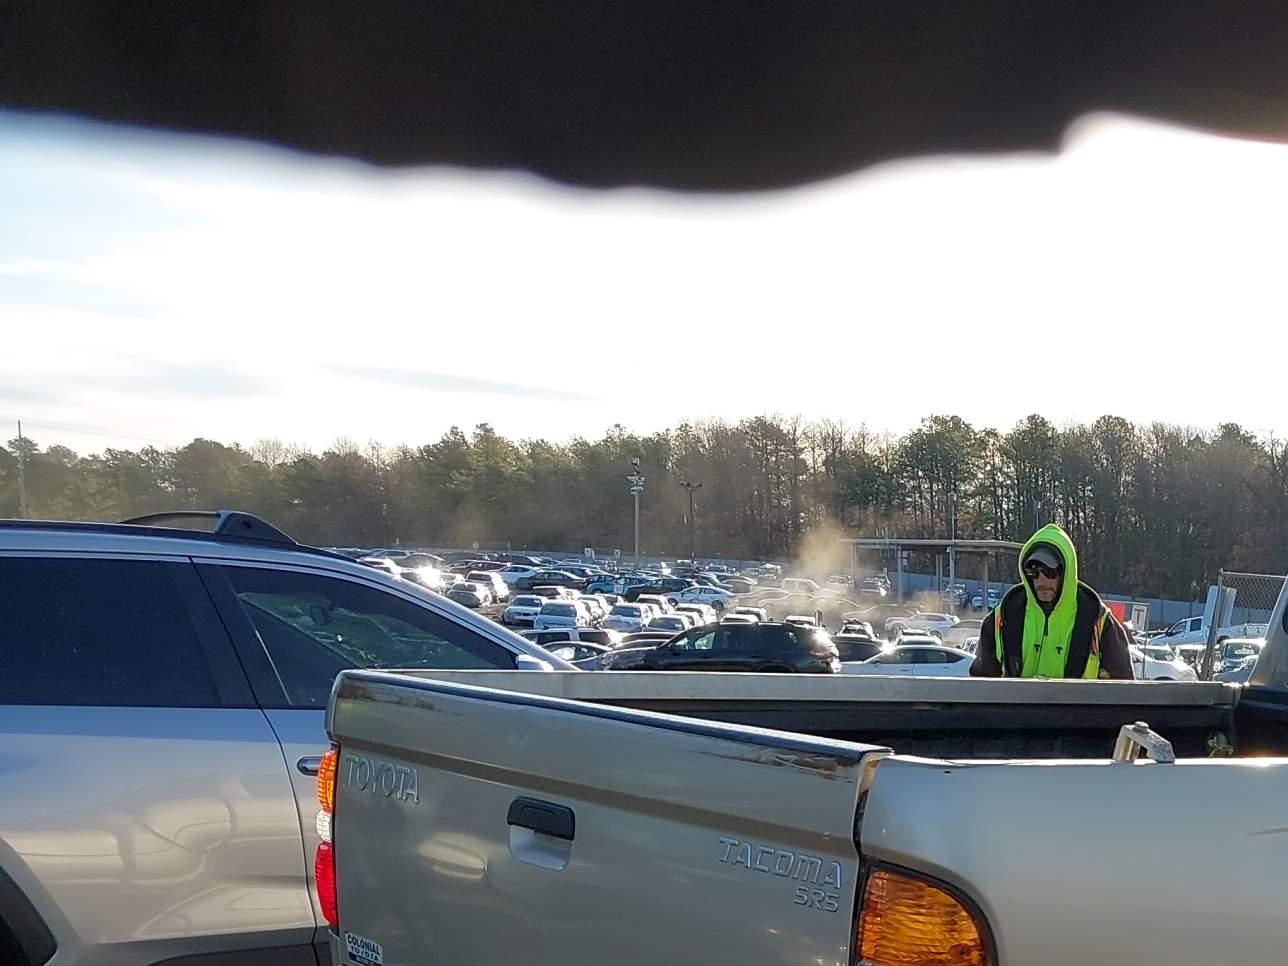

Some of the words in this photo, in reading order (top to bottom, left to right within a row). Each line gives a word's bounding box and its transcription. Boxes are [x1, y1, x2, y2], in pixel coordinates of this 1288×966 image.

[344, 755, 421, 805] TOYOTA
[718, 836, 842, 890] TACOMA
[347, 934, 381, 956] COLONIAL
